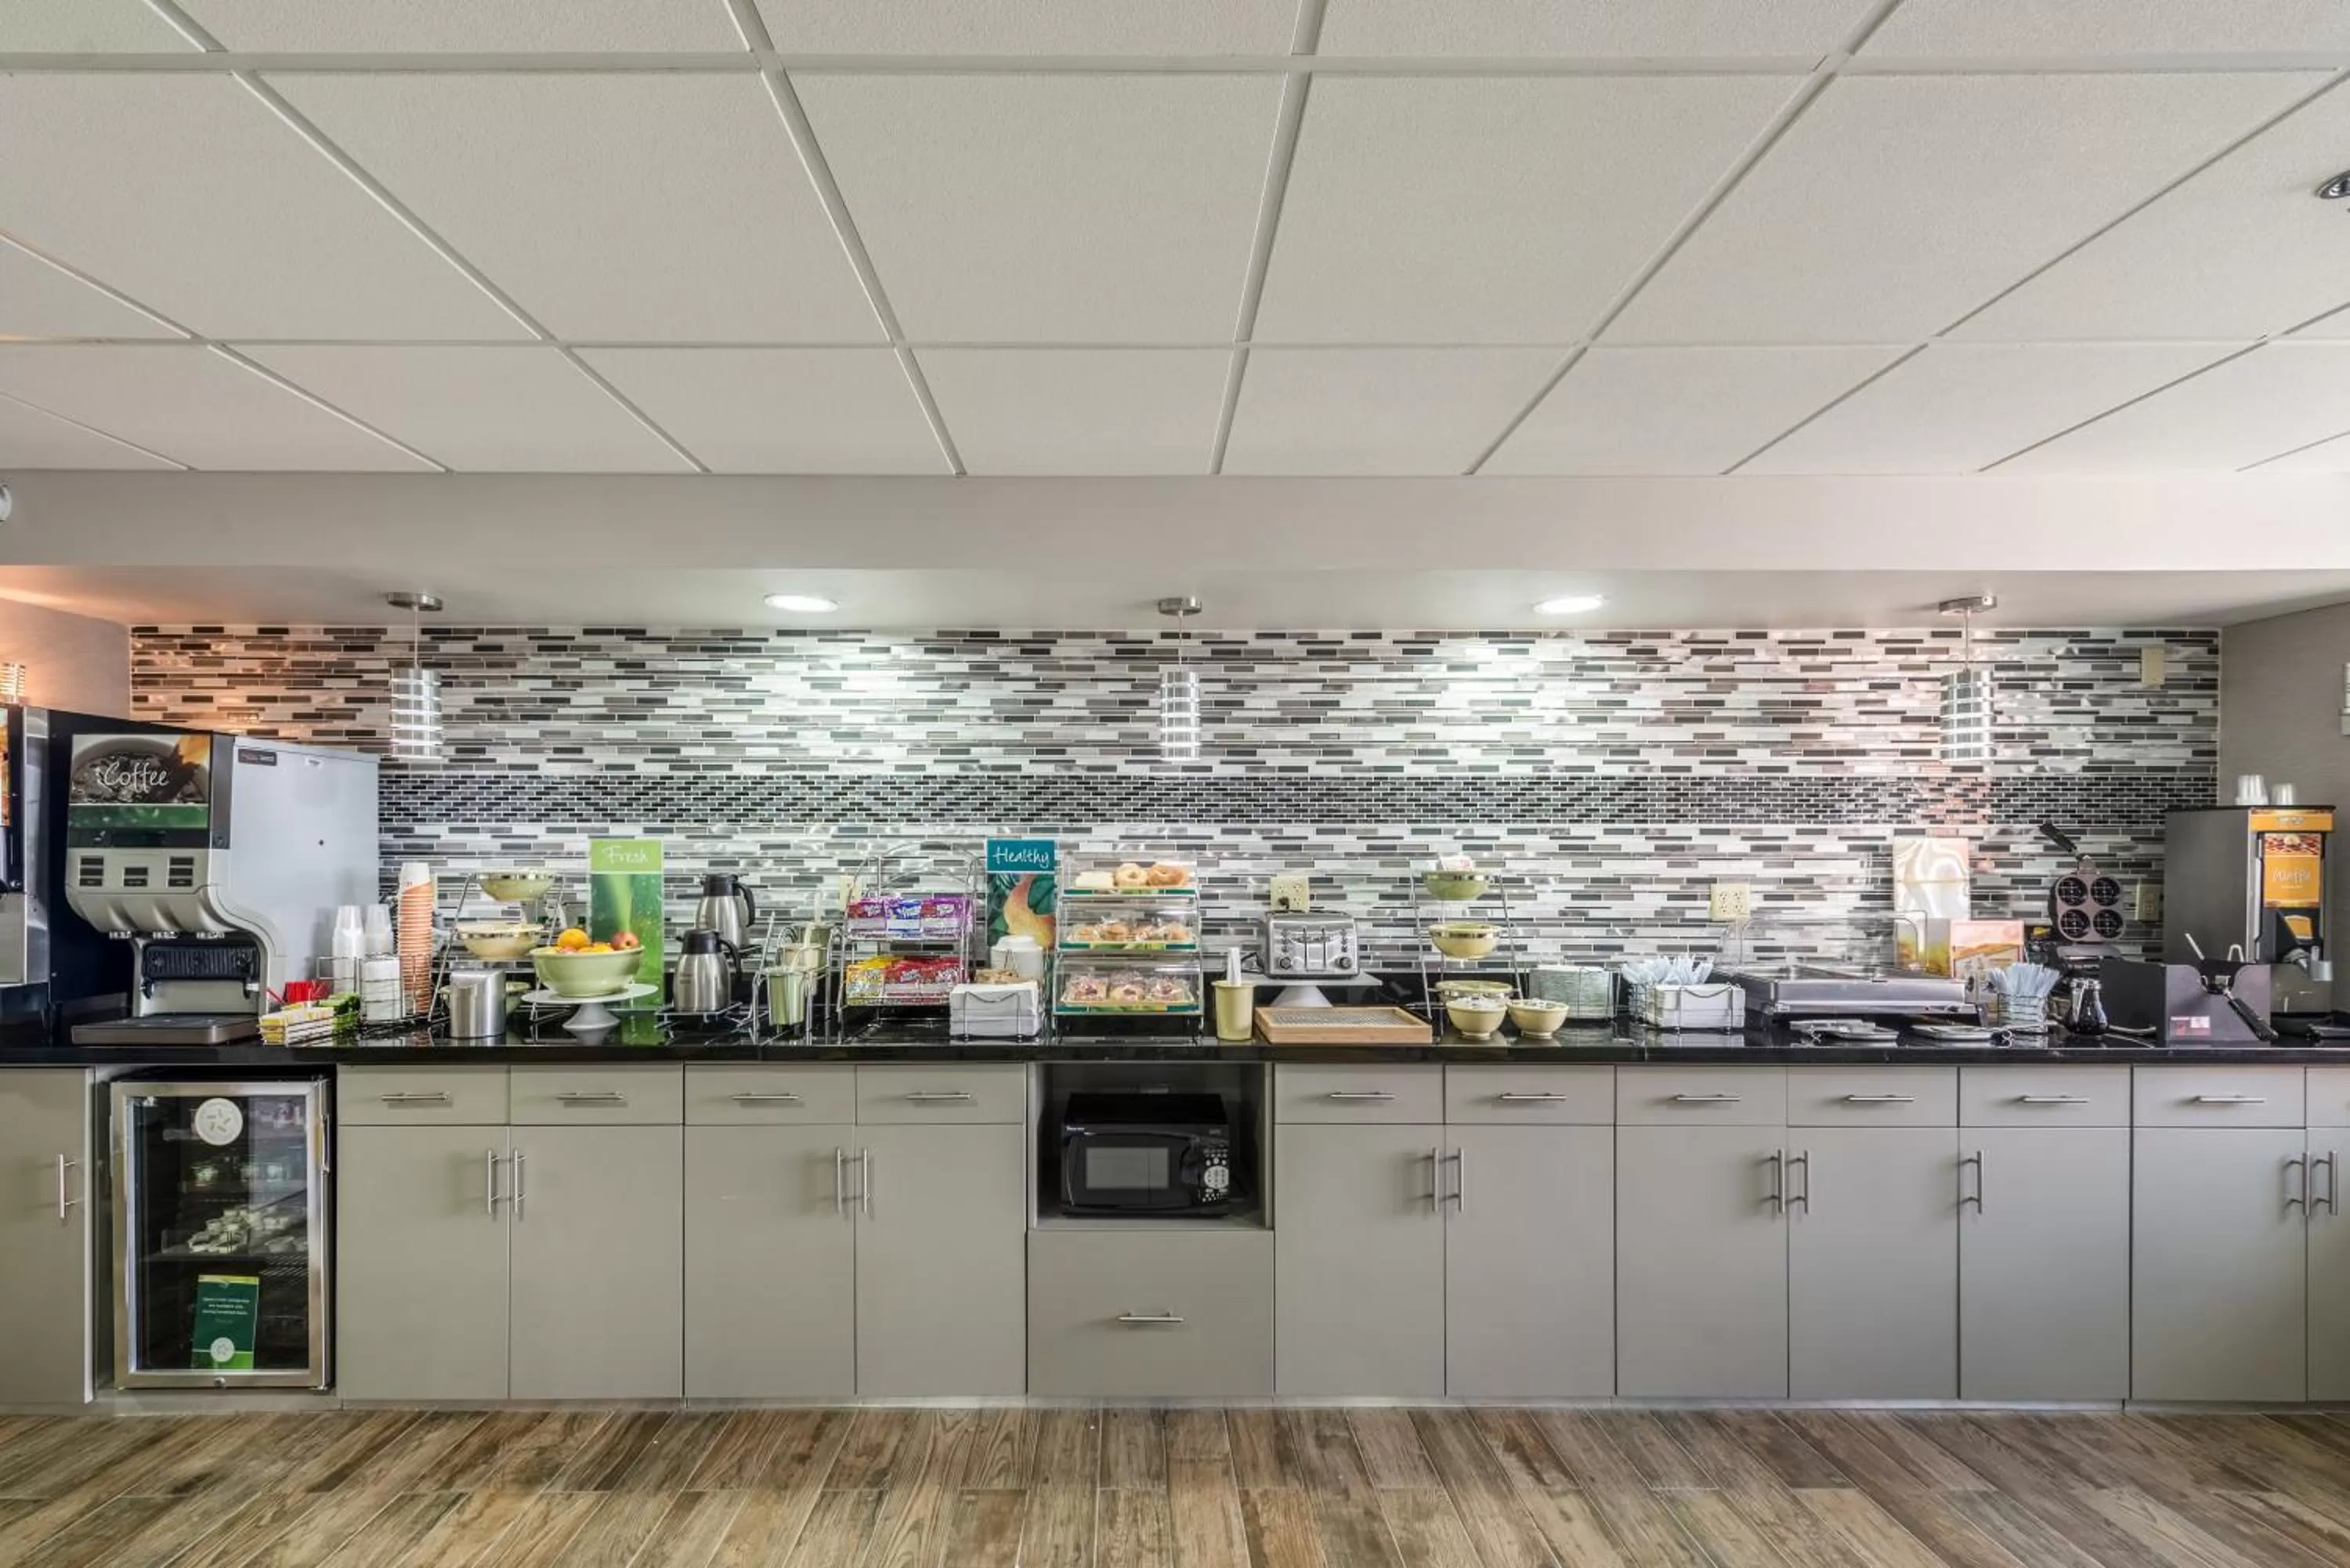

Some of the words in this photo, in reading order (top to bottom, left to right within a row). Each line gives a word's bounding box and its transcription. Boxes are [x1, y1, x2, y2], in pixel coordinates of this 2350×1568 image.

[104, 761, 168, 793] Coffee
[602, 845, 649, 864] Fresh
[993, 846, 1050, 869] Healthy
